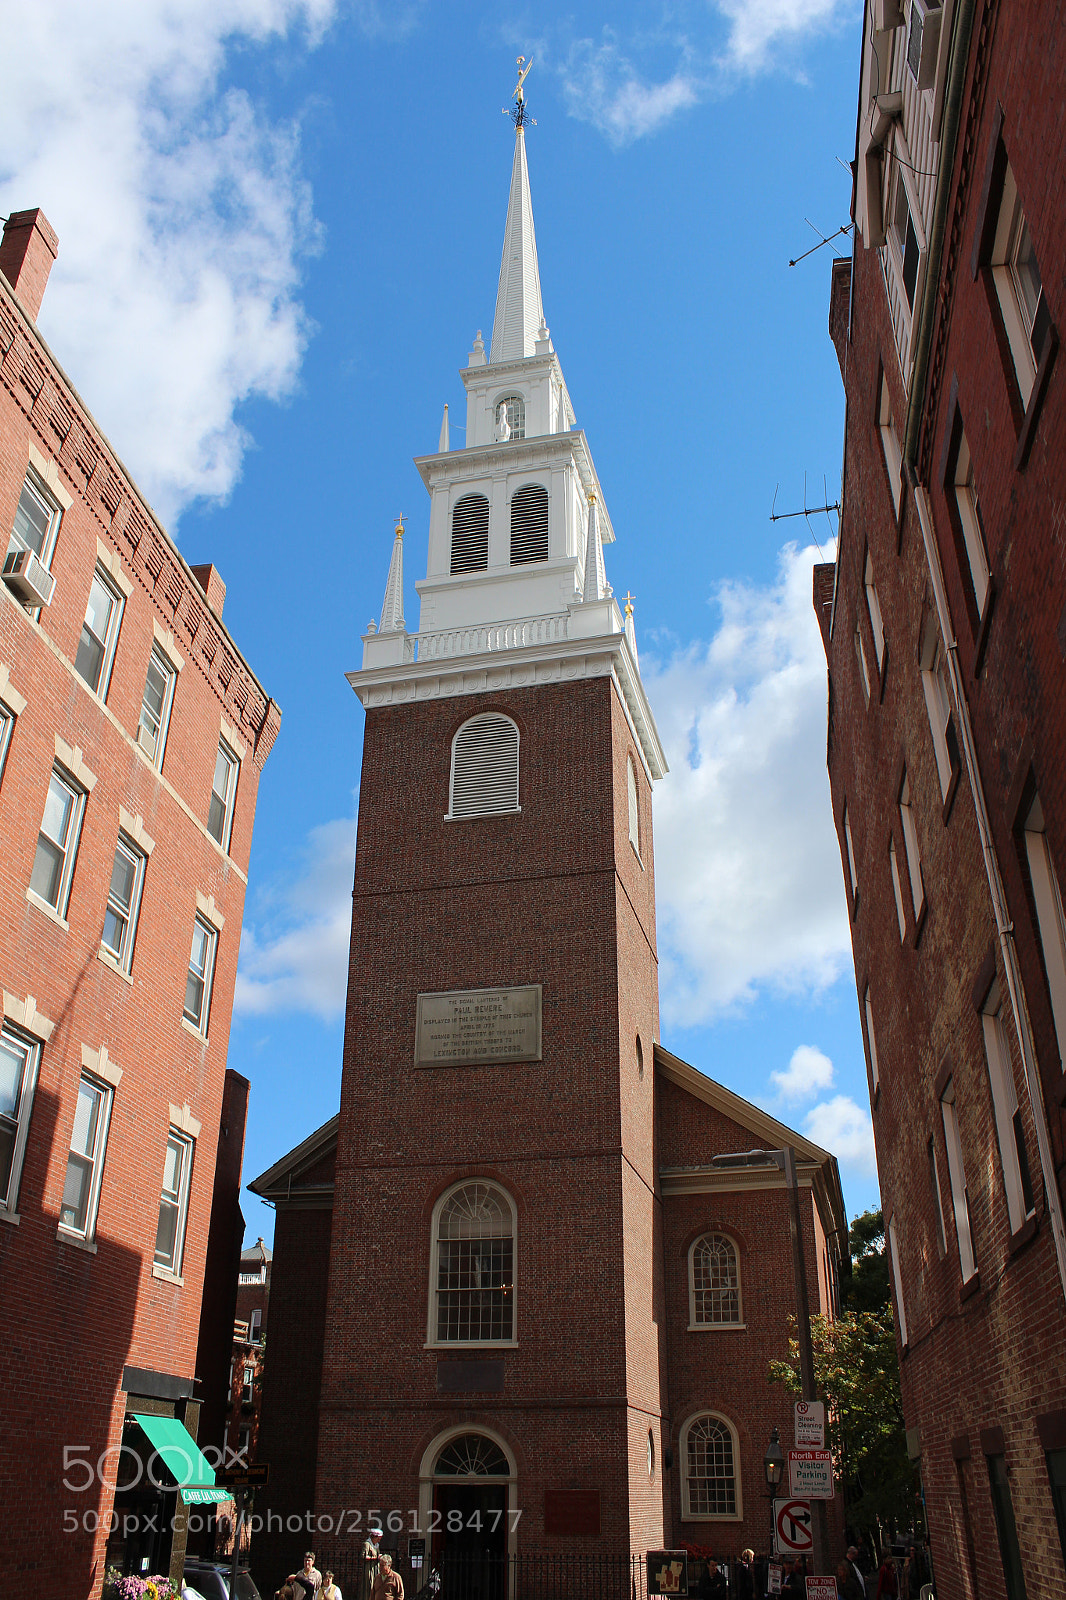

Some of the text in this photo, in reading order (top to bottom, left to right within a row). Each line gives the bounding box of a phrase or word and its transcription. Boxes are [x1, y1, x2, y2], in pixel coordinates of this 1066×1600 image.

[475, 1004, 502, 1013] REVERE
[434, 1048, 470, 1057] LEXINGTON
[797, 1471, 827, 1480] Parking
[183, 1490, 201, 1500] CAFFE
